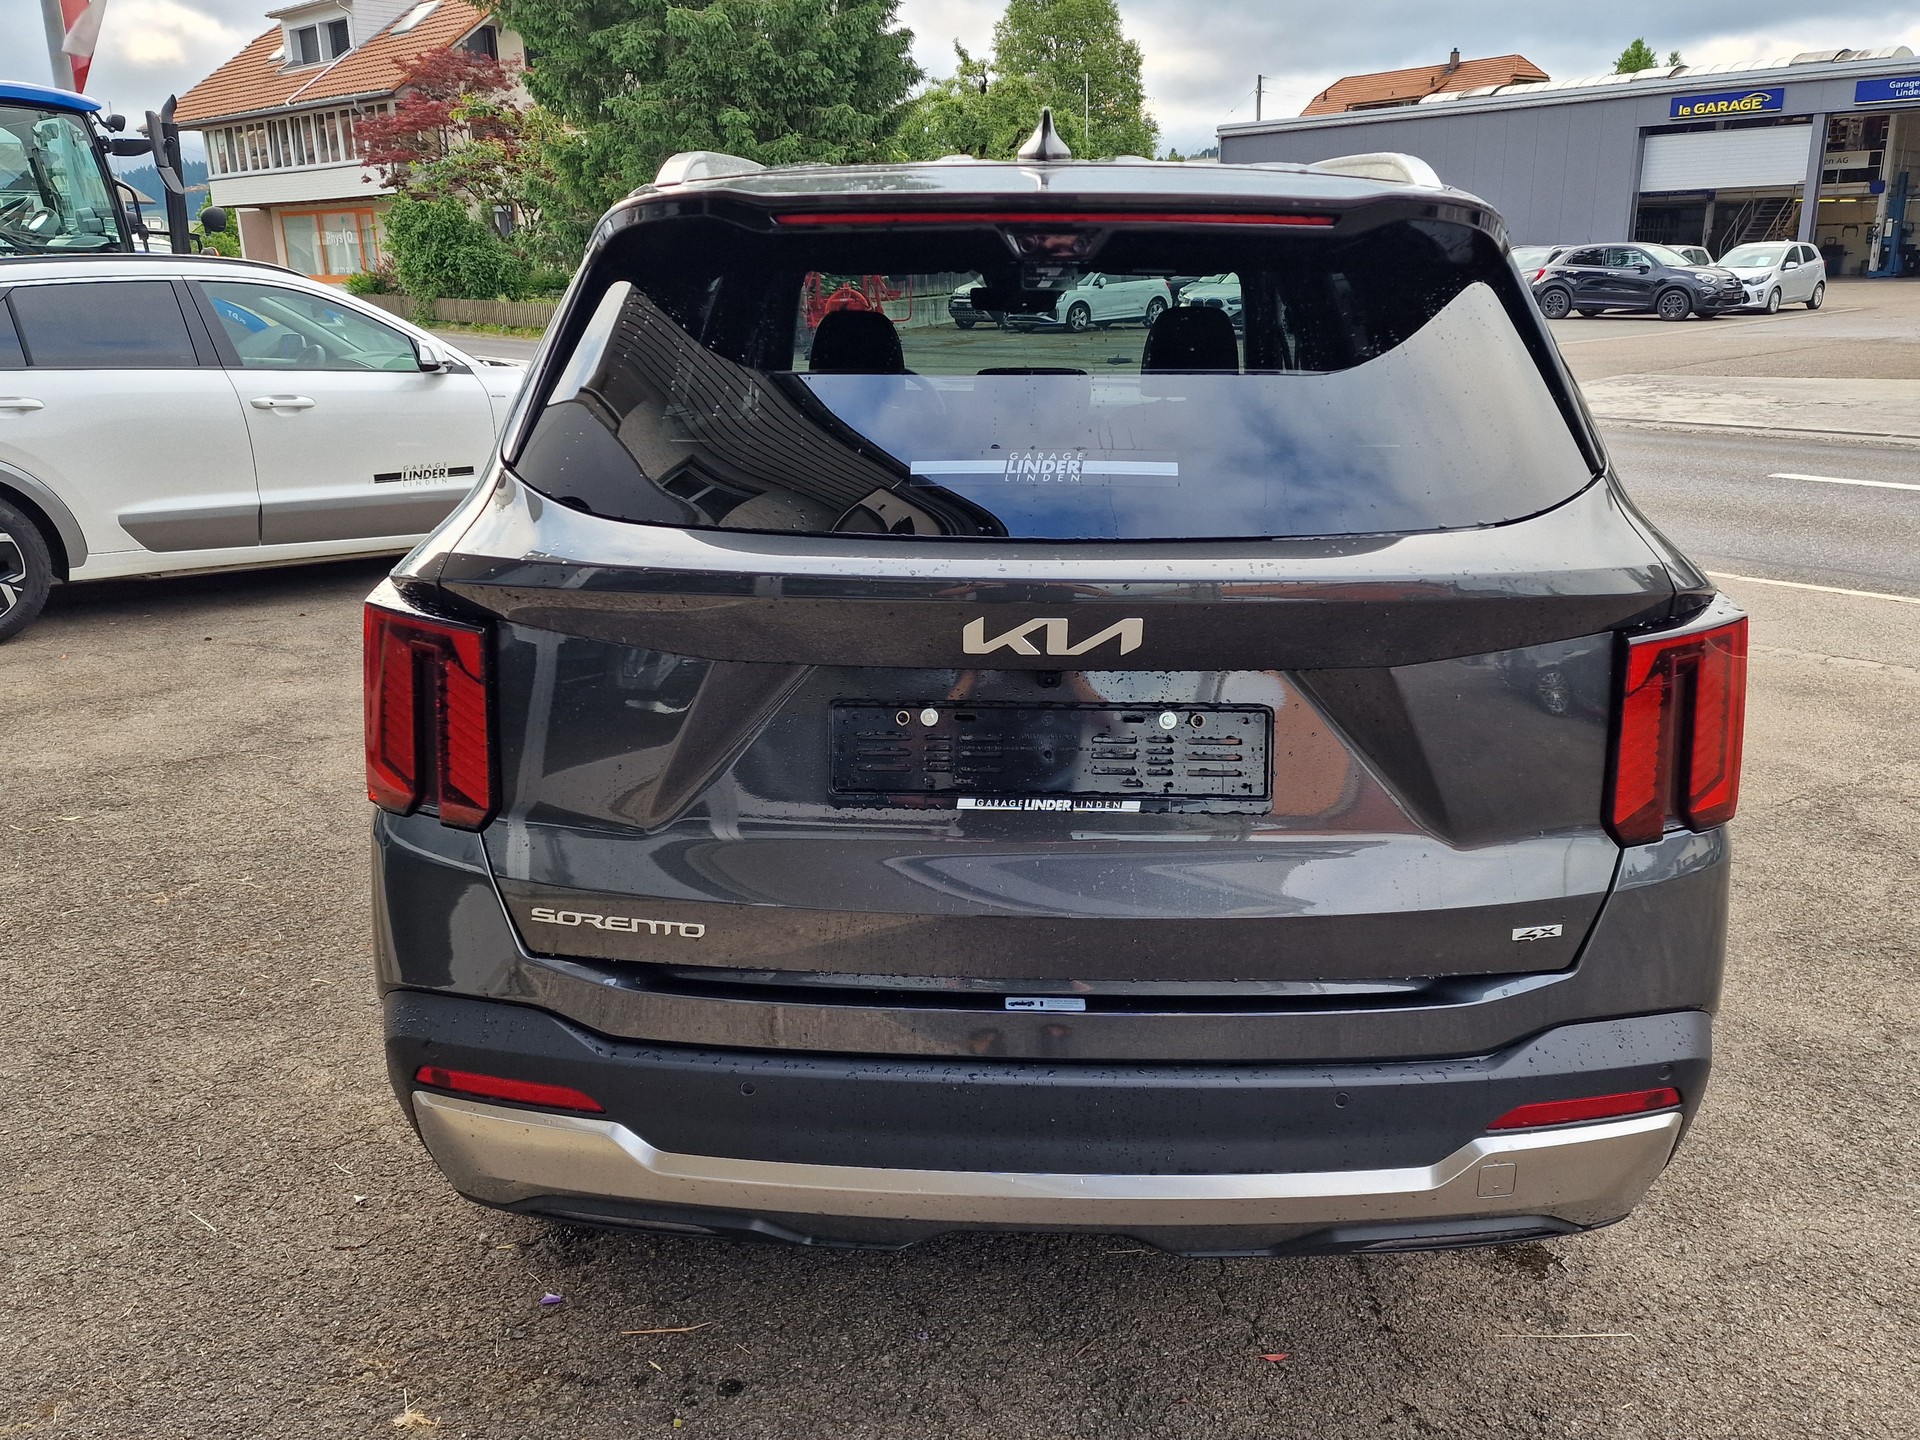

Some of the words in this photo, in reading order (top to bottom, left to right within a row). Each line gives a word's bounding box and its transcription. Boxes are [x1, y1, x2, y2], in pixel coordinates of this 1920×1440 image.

[1889, 80, 1920, 89] Garage
[1895, 89, 1920, 97] Linde
[1678, 105, 1691, 116] le
[1693, 97, 1763, 114] GARAGE
[1009, 452, 1083, 460] GARAGE
[403, 462, 447, 471] GARAGE
[1006, 460, 1080, 474] LINDER
[403, 468, 446, 482] LINDER
[1004, 473, 1080, 482] LINDEN
[403, 479, 447, 487] LINDEN
[962, 616, 1144, 656] KIA
[976, 798, 1024, 807] GARAGE
[1023, 798, 1073, 812] LINDER
[1073, 800, 1122, 809] LINDEN
[530, 907, 705, 938] SORENTO
